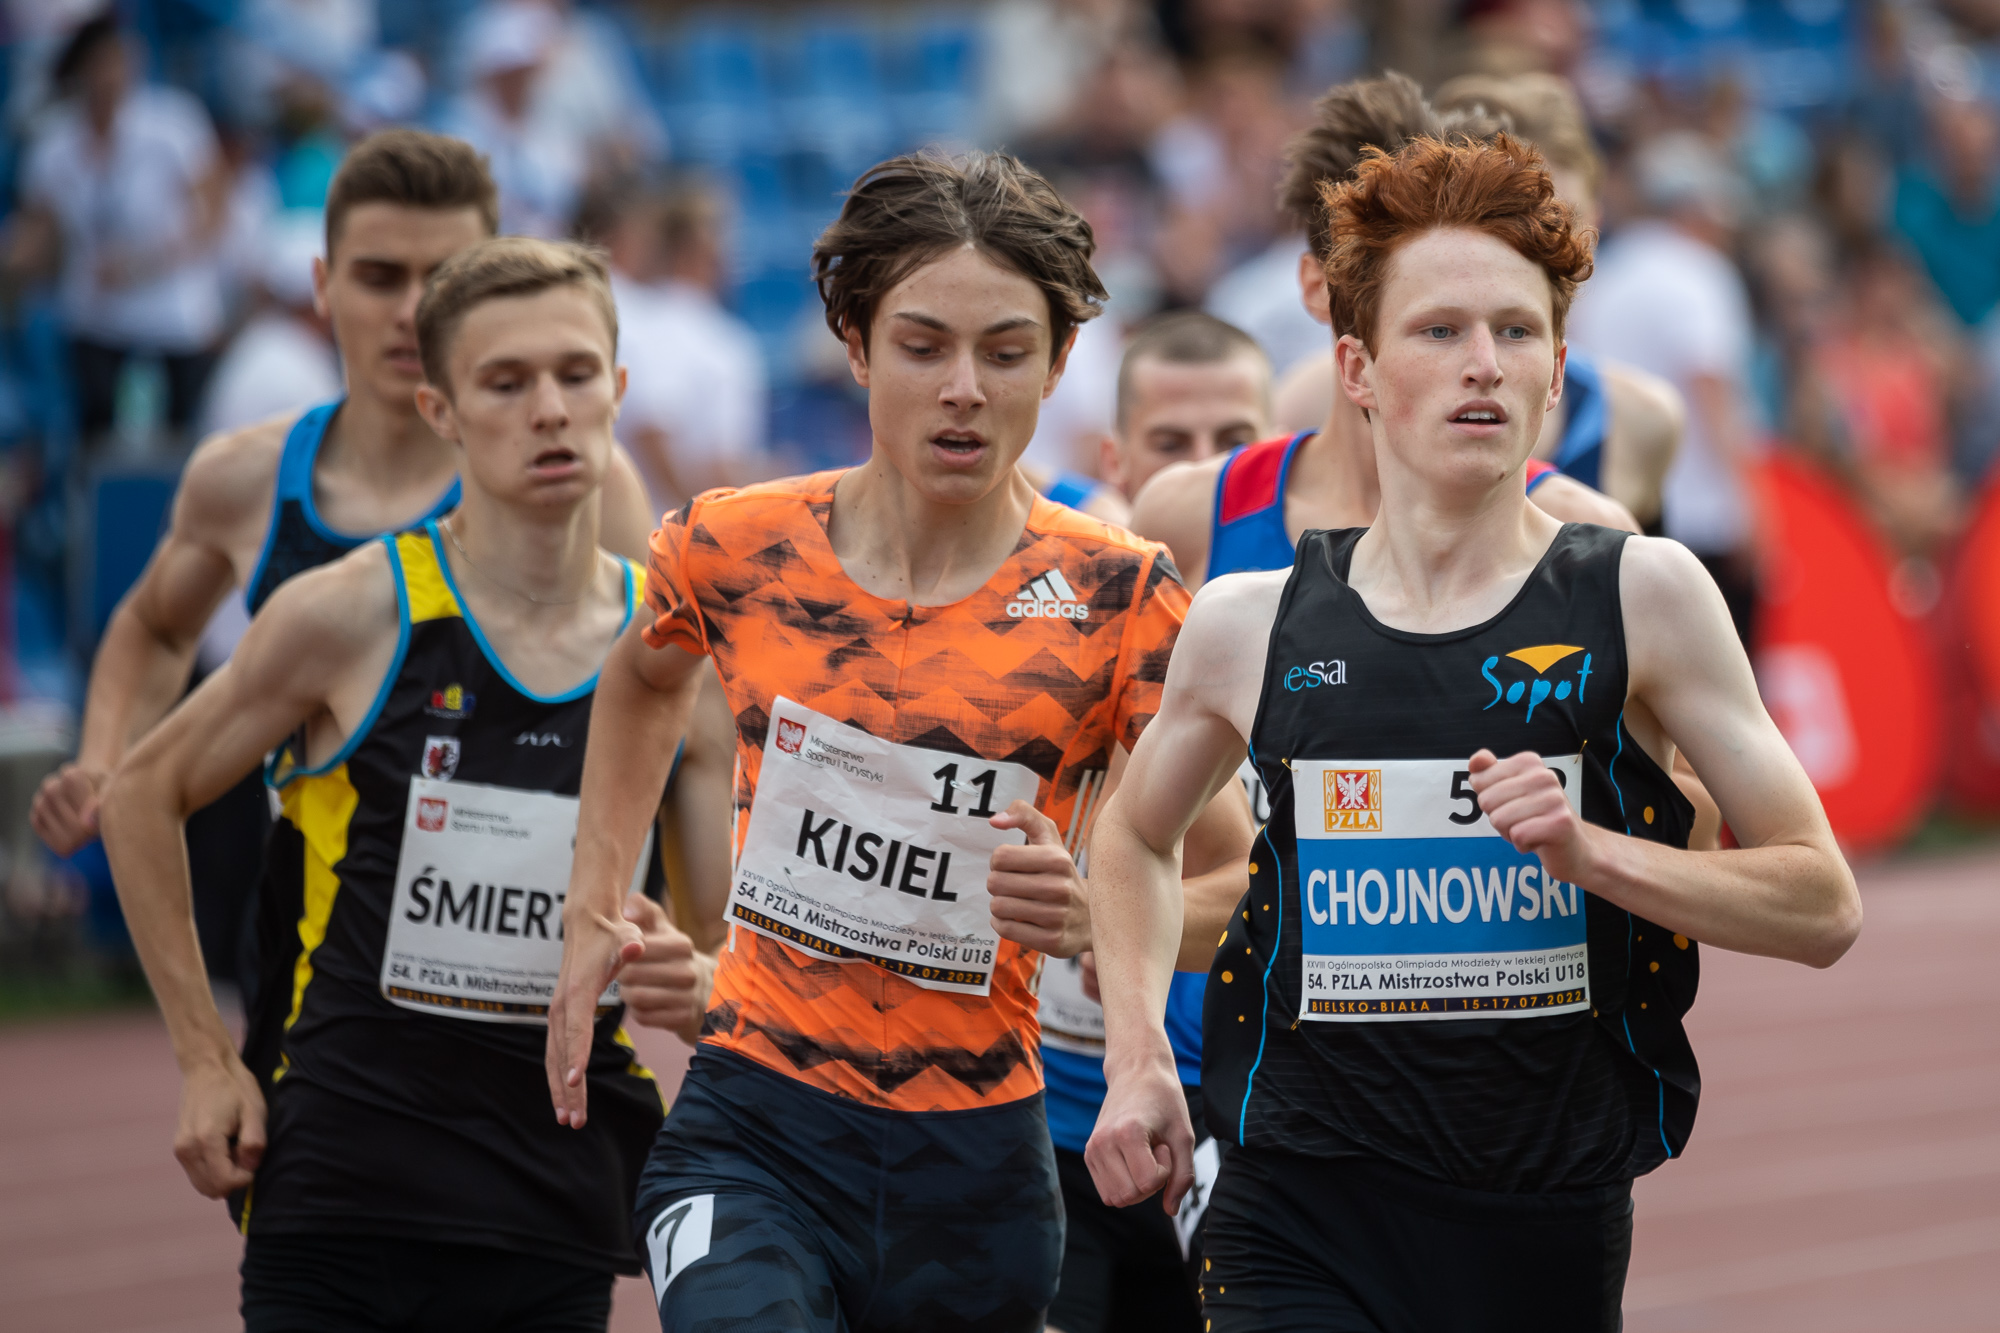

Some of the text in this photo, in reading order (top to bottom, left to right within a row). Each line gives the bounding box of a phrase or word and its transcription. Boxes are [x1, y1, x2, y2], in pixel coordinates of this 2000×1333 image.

[1006, 599, 1089, 620] adidas
[1481, 653, 1593, 724] Sopot
[805, 748, 836, 766] Sportu
[842, 760, 885, 783] Turystyki
[810, 735, 865, 764] Ministerstwo
[930, 763, 997, 819] 11
[1327, 811, 1379, 829] PZLA
[796, 808, 958, 902] KISIEL
[765, 879, 822, 908] Ogólnopolska
[822, 903, 869, 926] Olimpiada
[1307, 866, 1578, 925] CHOJNOWSKI
[736, 905, 983, 984] BIELSKO-BIAŁA 15-17.07.2022
[737, 881, 993, 965] 54. PZLA Mistrzostwa Polski U18
[1306, 960, 1326, 970] XXVIII
[1327, 960, 1392, 972] Ogólnopolska
[1395, 959, 1448, 970] Olimpiada
[1451, 958, 1501, 968] Młodzieży
[1515, 955, 1546, 966] lekkiej
[1549, 950, 1584, 963] atletyce
[1308, 962, 1585, 990] 54. PZLA Mistrzostwa Polski U18
[1312, 990, 1581, 1013] BIELSKO-BIAŁA 15-17.07.2022
[654, 1202, 693, 1281] 7
